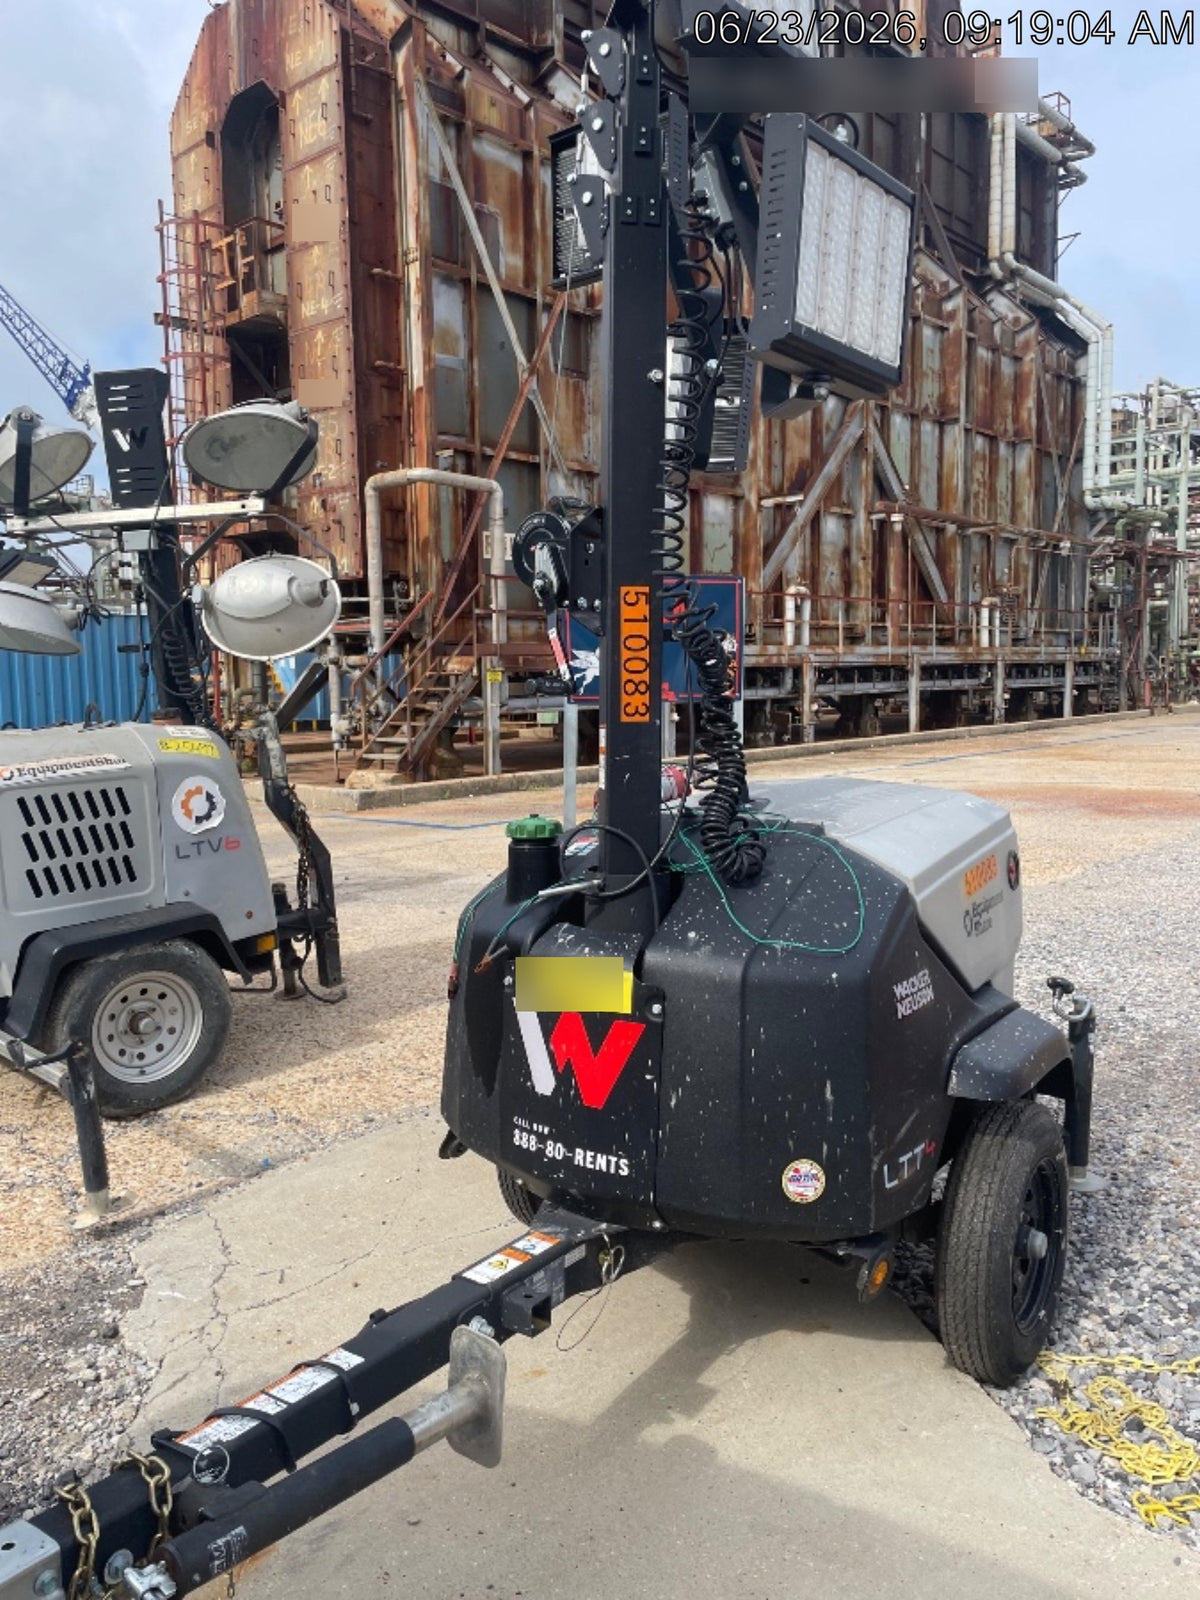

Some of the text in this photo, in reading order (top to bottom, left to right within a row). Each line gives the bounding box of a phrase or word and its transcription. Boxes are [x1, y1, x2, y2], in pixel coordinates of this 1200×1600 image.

[622, 590, 649, 718] 510083
[174, 834, 242, 860] LTV6
[512, 1127, 630, 1177] 888-80-RENTS
